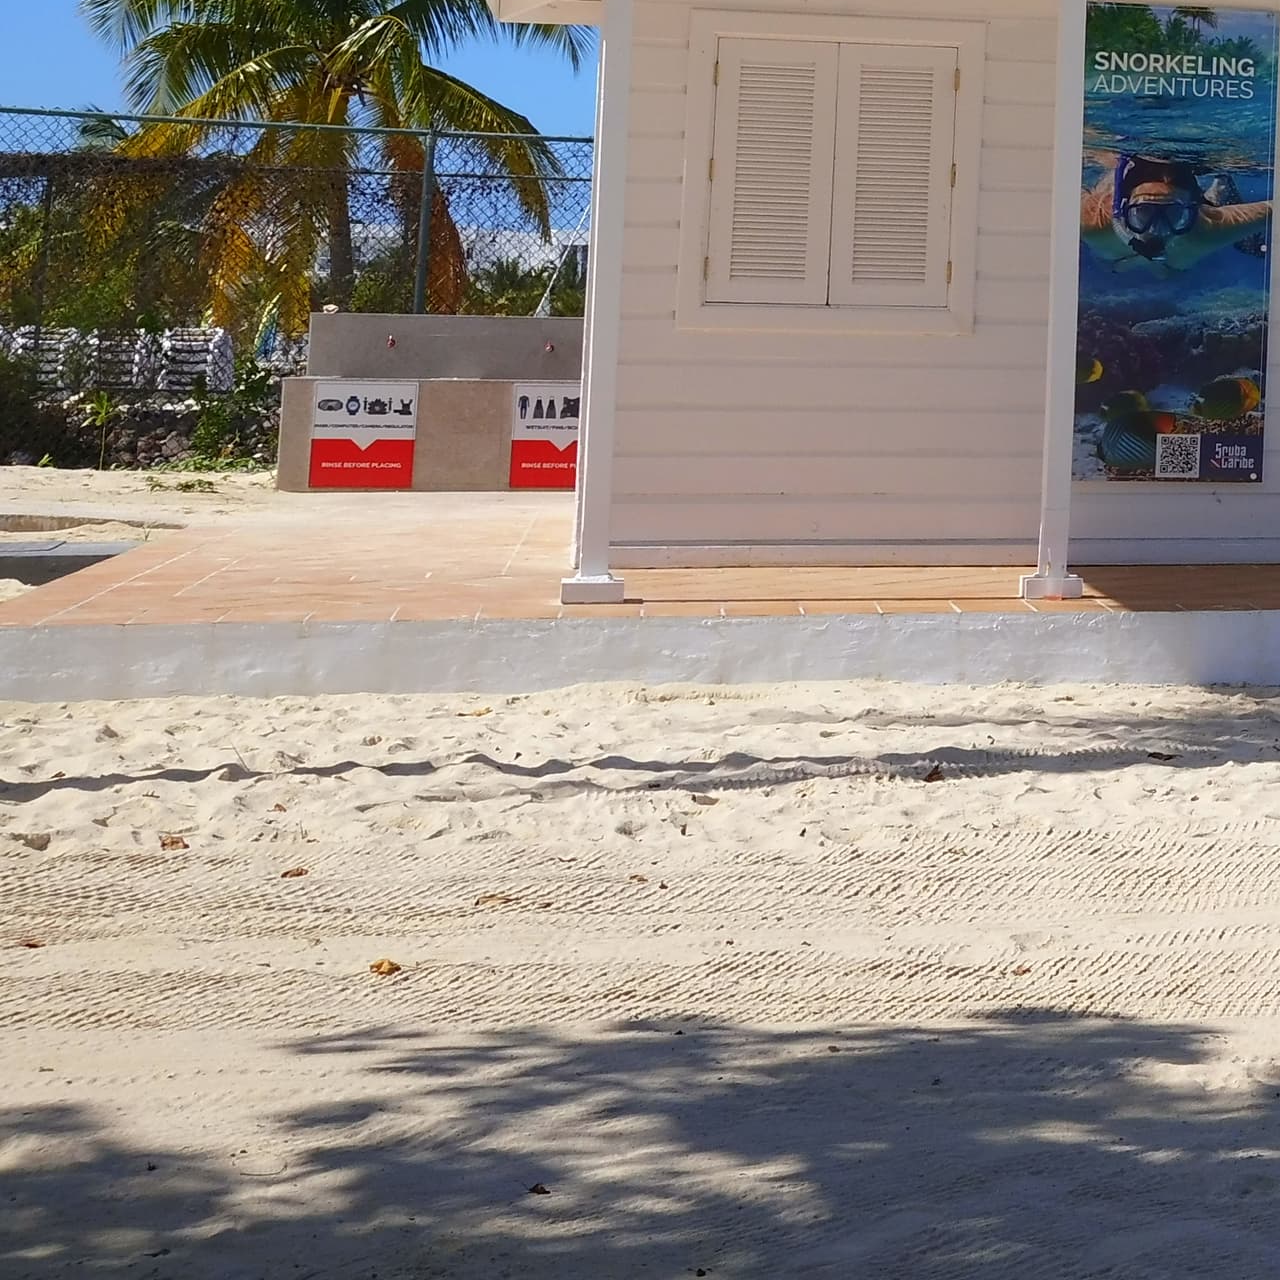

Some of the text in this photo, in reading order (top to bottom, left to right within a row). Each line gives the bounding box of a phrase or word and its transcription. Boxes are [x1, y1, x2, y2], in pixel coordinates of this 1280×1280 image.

[1094, 51, 1255, 77] SNORKELING
[1092, 74, 1254, 99] ADVENTURES
[1215, 443, 1247, 459] Scuba
